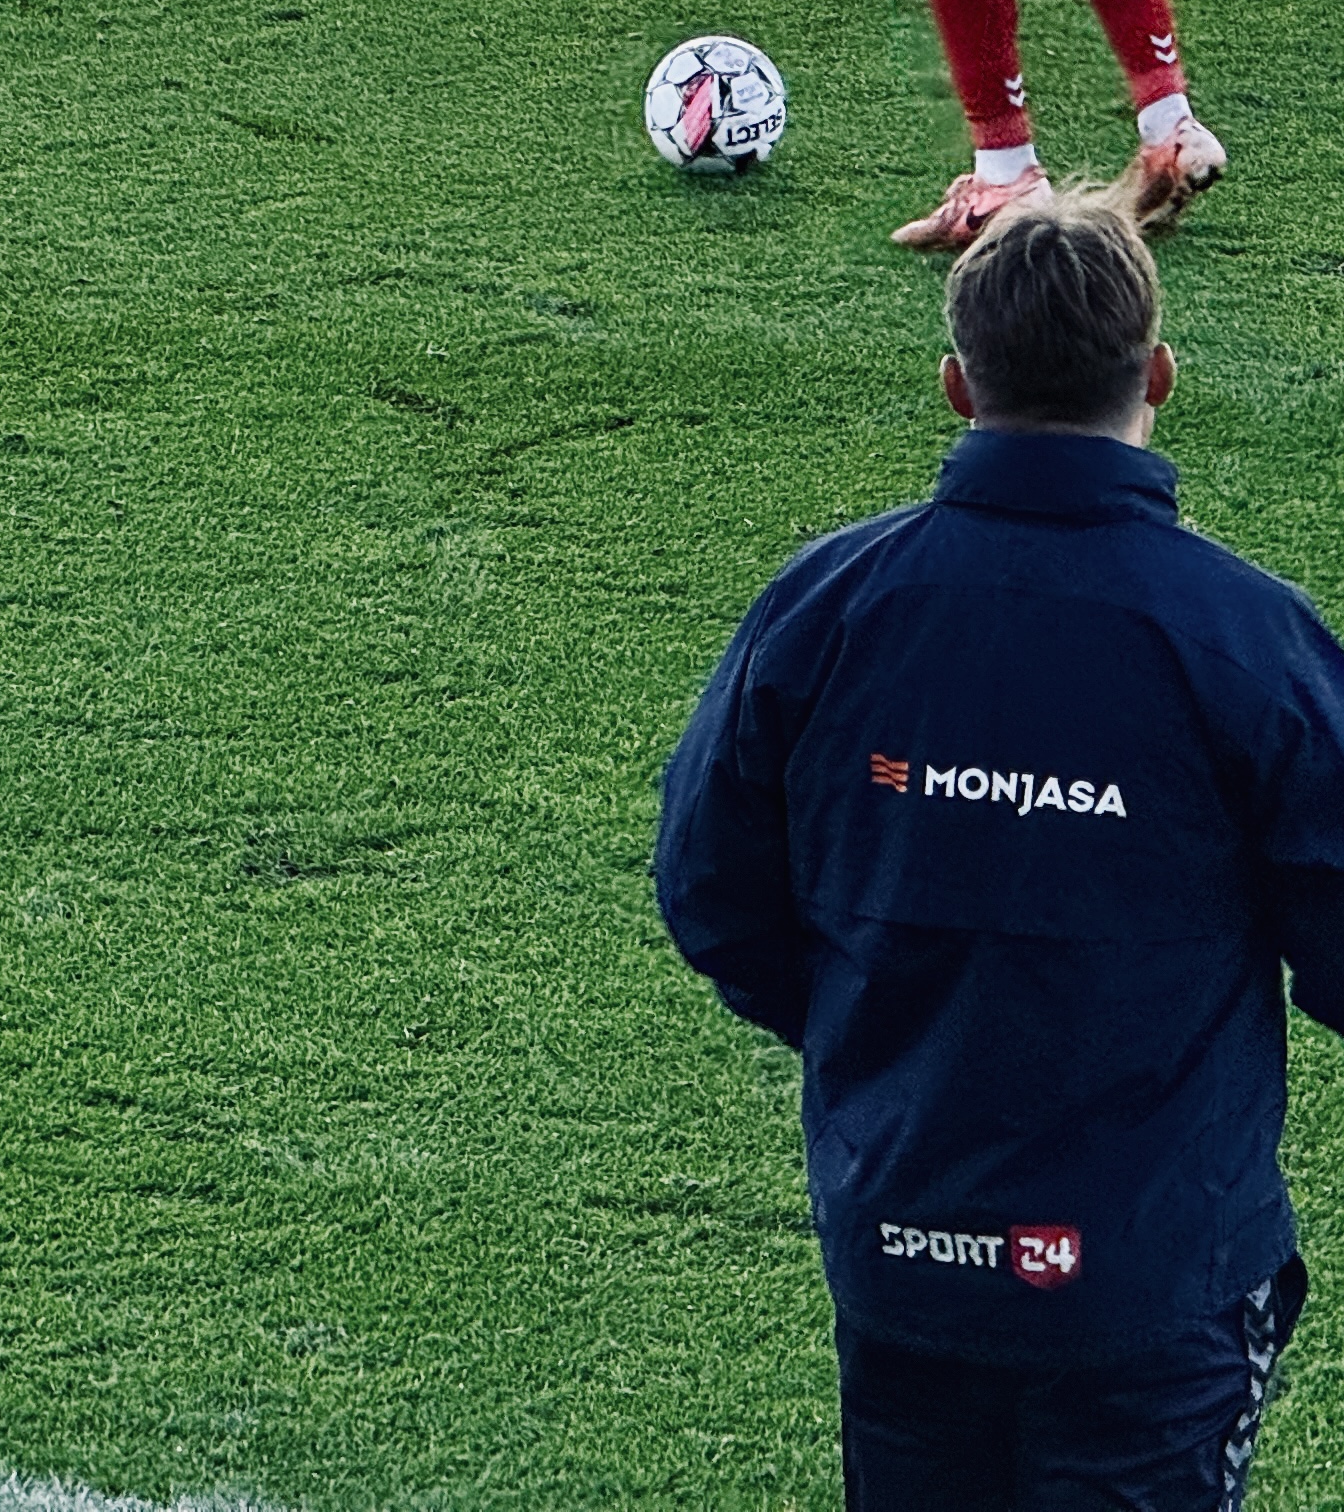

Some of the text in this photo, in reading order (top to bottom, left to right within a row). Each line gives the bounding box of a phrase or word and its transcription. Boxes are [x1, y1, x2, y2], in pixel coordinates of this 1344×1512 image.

[924, 763, 1127, 819] MONJASA
[879, 1221, 1077, 1274] SPORT 24
